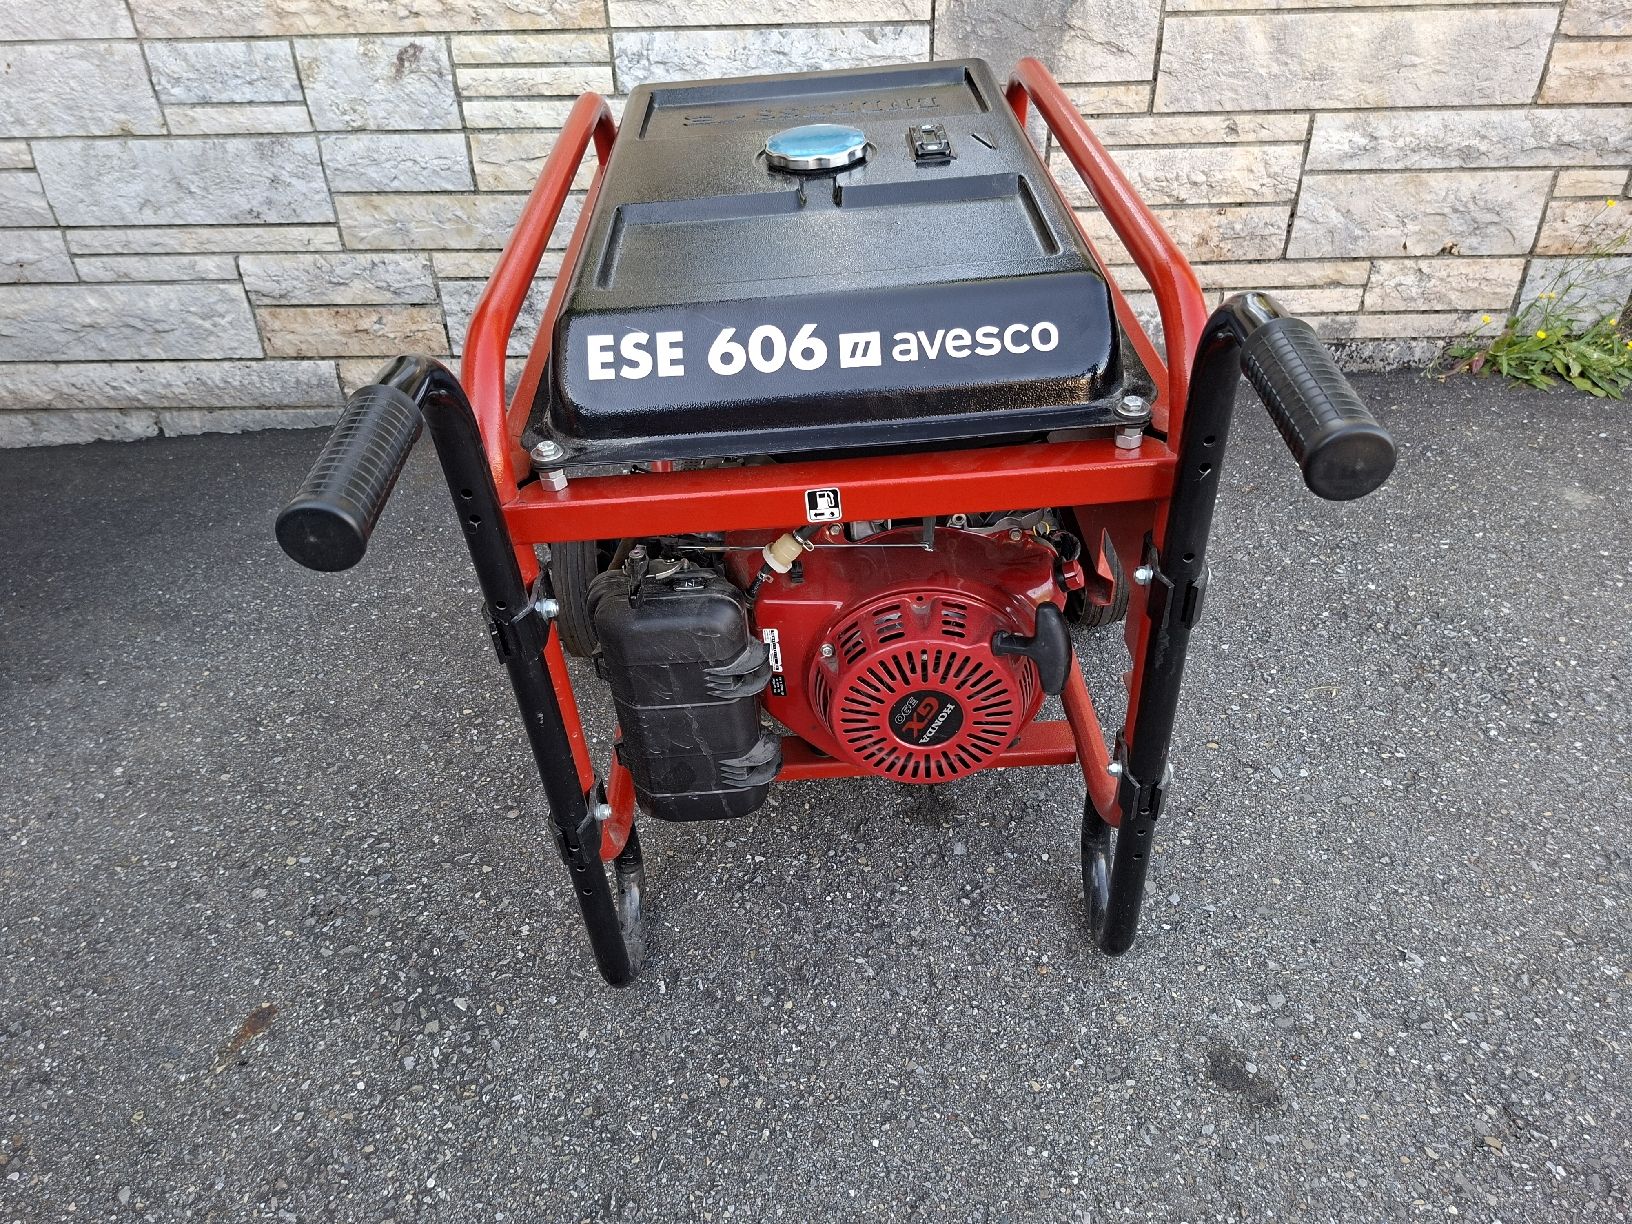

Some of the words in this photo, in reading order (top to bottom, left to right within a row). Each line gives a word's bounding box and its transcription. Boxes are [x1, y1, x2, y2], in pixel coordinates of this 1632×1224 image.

[586, 330, 685, 381] ESE
[707, 323, 828, 376] 606
[891, 321, 1060, 362] avesco
[901, 696, 939, 739] GX
[918, 703, 956, 744] HONDA
